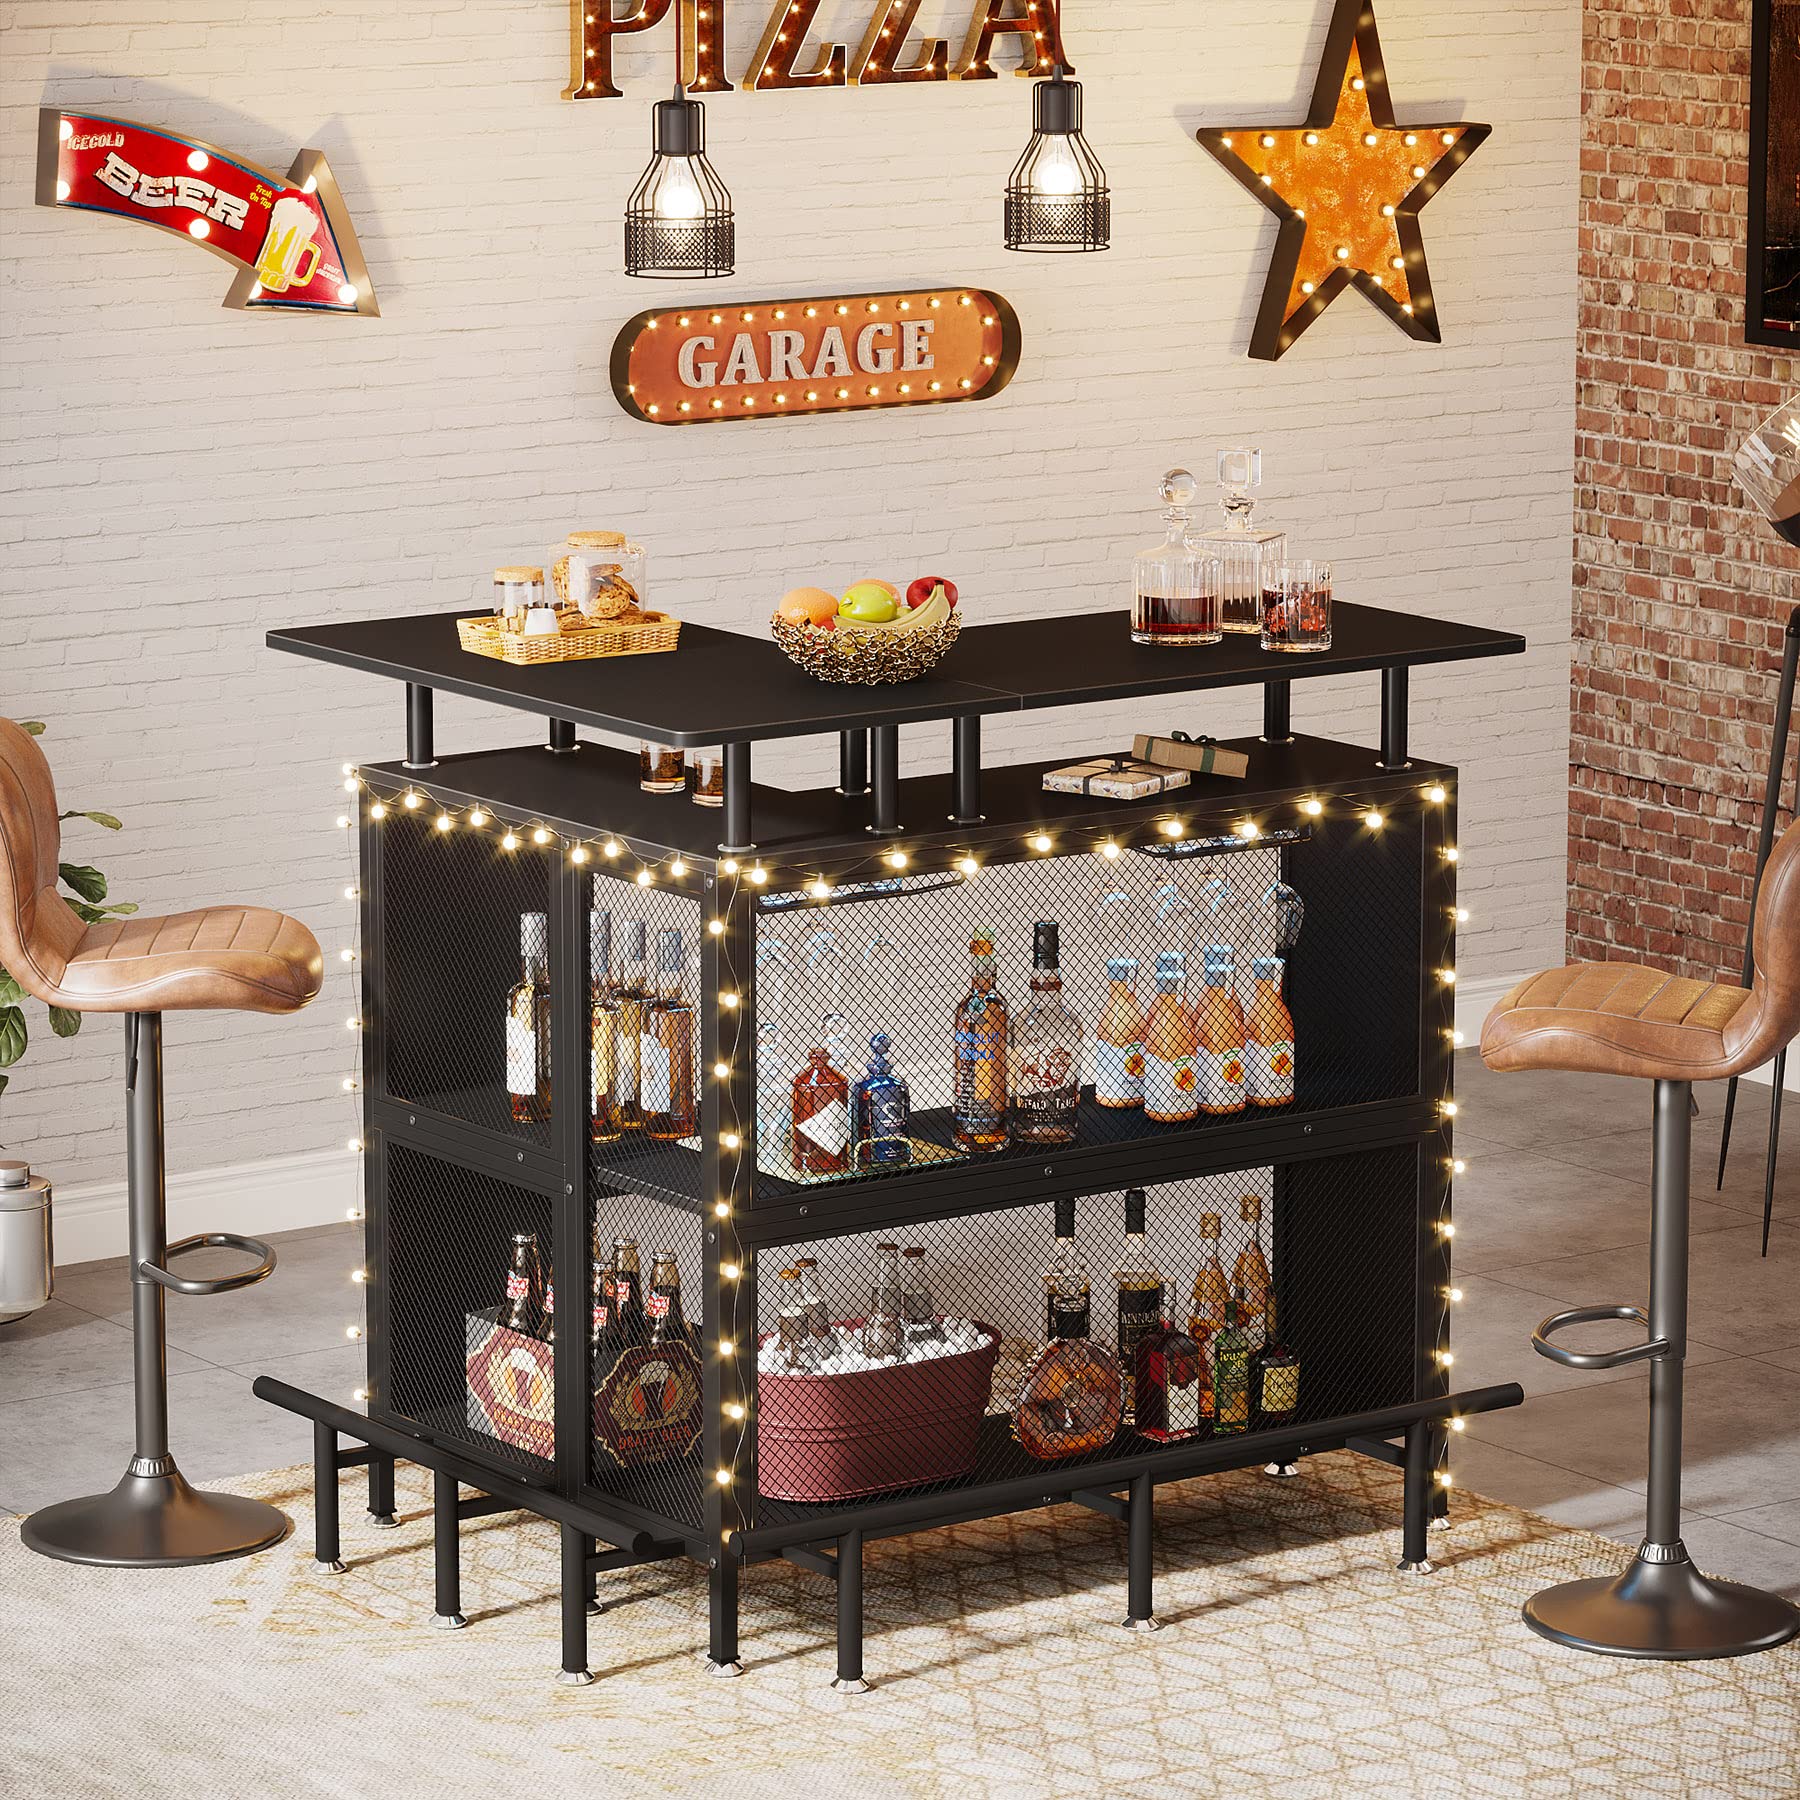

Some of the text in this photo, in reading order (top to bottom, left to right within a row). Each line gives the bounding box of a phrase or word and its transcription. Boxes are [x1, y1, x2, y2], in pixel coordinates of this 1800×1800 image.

[561, 0, 1076, 100] PIZZA
[93, 151, 251, 231] BEER
[249, 192, 259, 202] On
[677, 319, 935, 389] GARAGE
